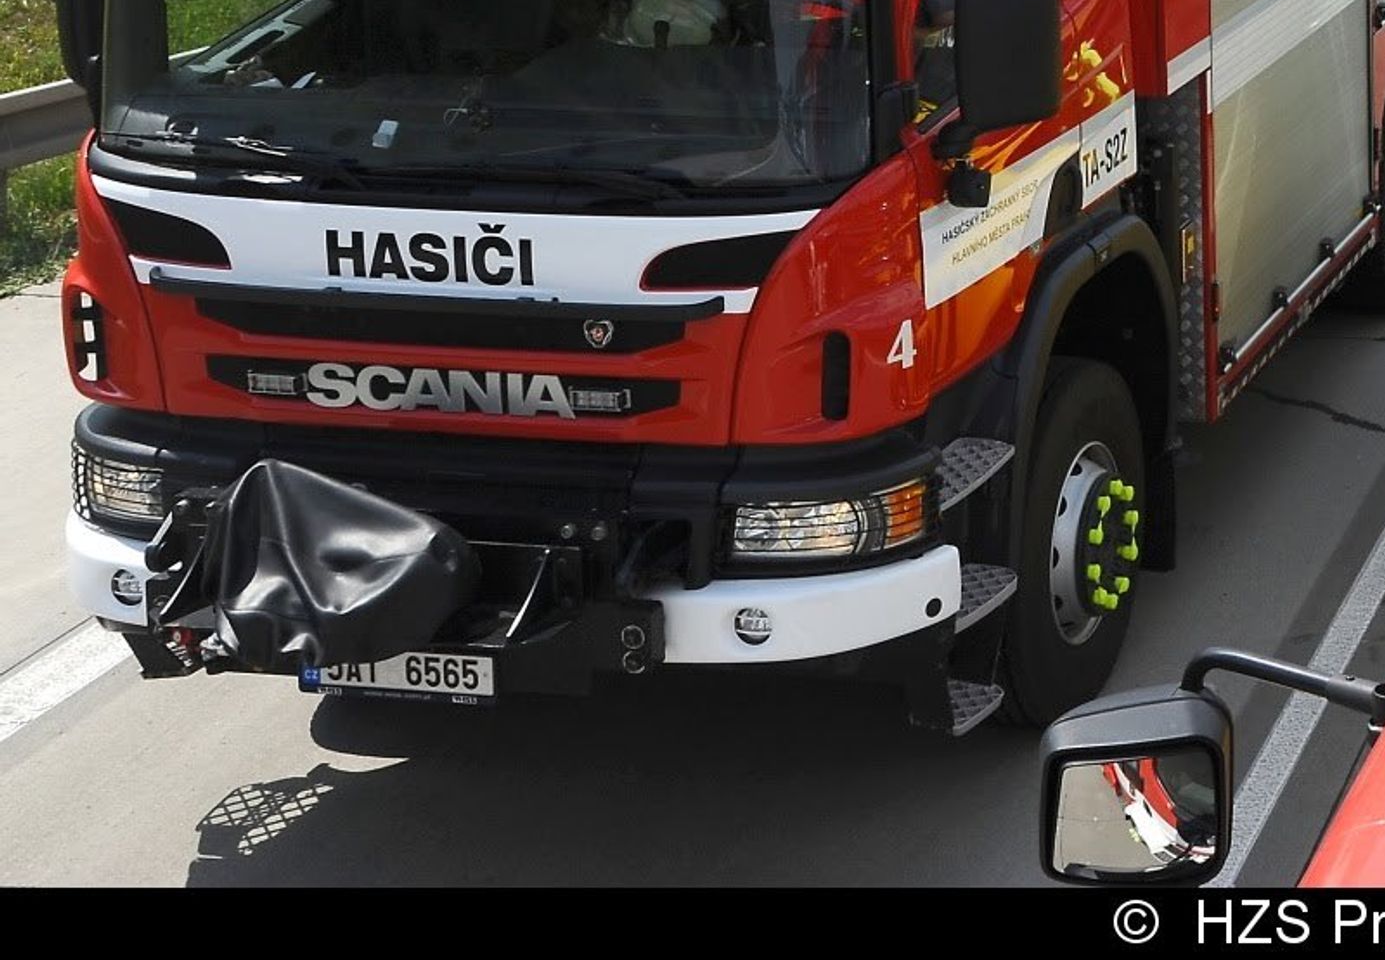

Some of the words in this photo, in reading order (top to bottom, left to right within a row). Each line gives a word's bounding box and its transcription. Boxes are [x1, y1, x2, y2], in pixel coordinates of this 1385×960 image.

[1083, 127, 1128, 189] TA-S2Z
[325, 222, 535, 287] HASIČI
[886, 319, 917, 369] 4
[306, 362, 576, 420] SCANIA
[304, 669, 319, 680] CZ
[405, 655, 479, 691] 6565
